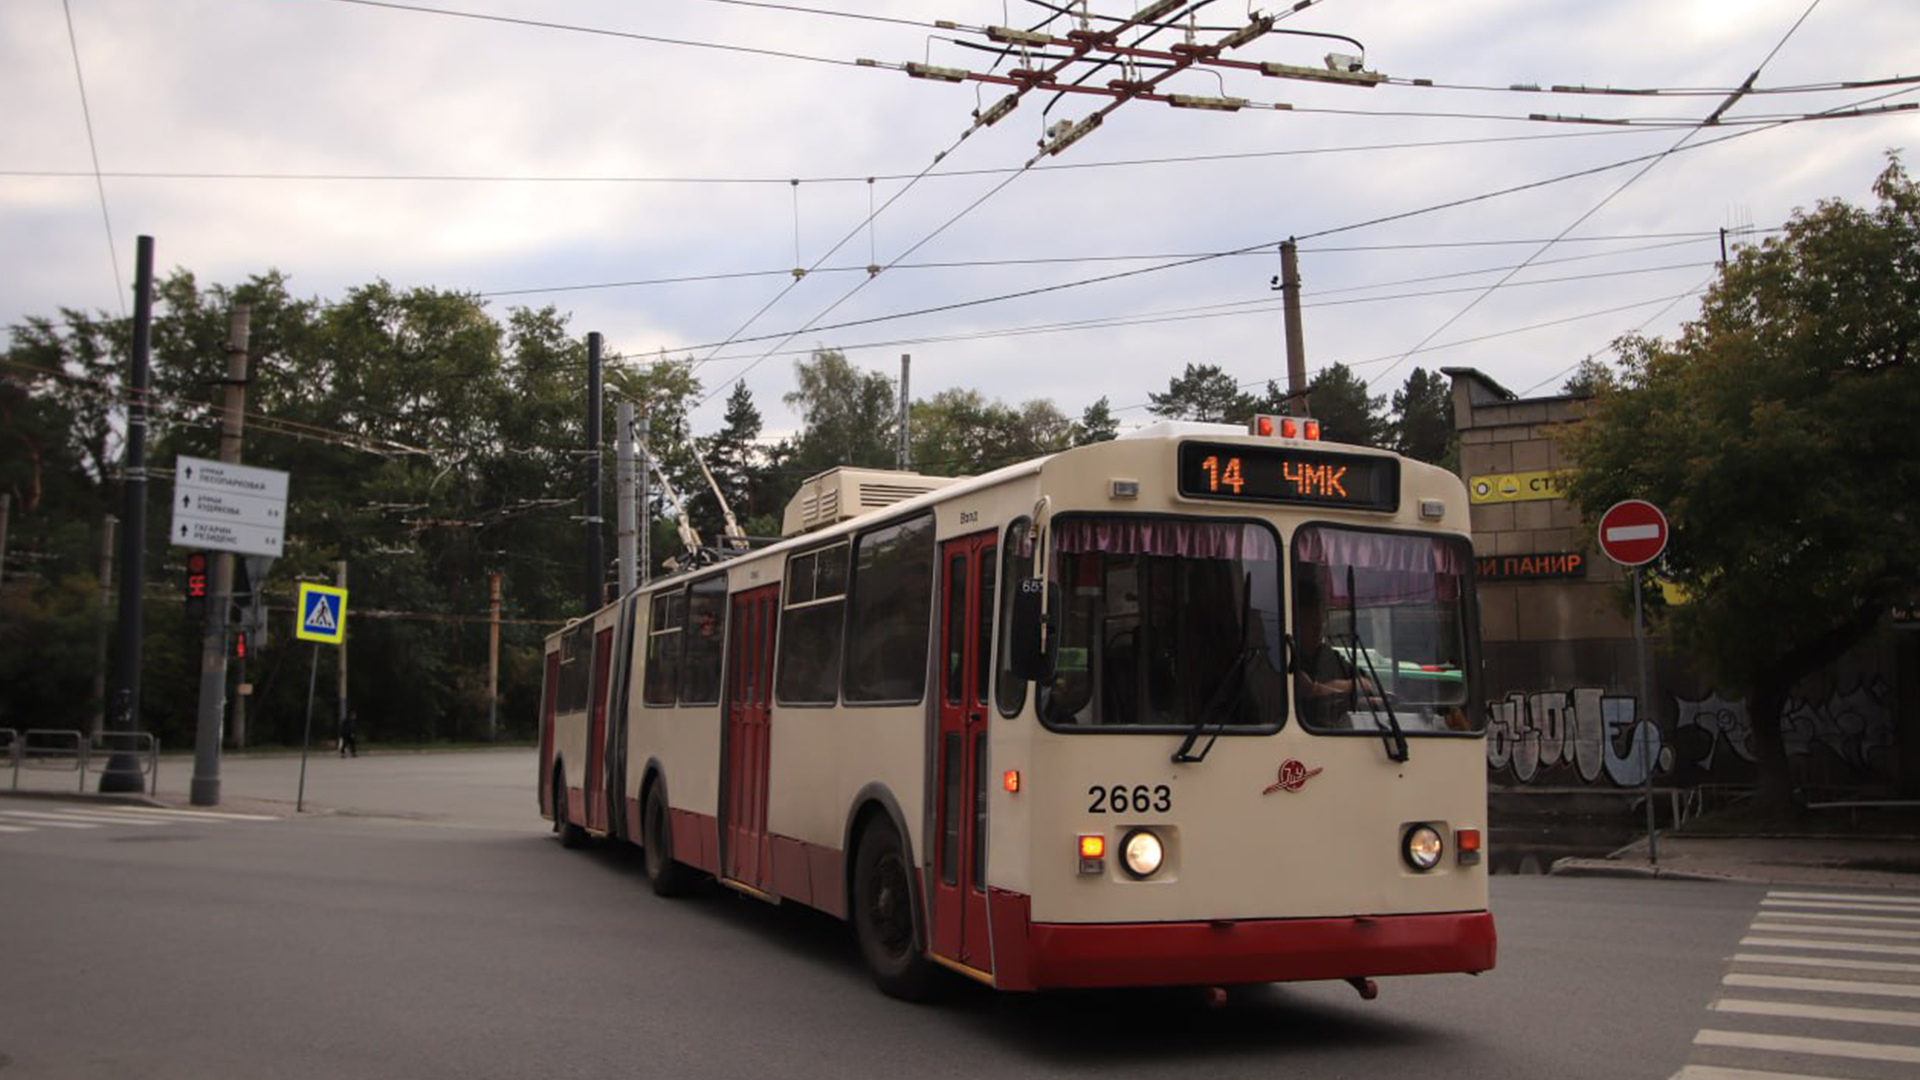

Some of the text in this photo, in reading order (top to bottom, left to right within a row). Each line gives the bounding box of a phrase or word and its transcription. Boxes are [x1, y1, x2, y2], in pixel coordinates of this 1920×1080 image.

[1203, 456, 1347, 497] 14 ЧМК
[1504, 554, 1582, 576] ПАНИР
[1088, 784, 1171, 813] 2663
